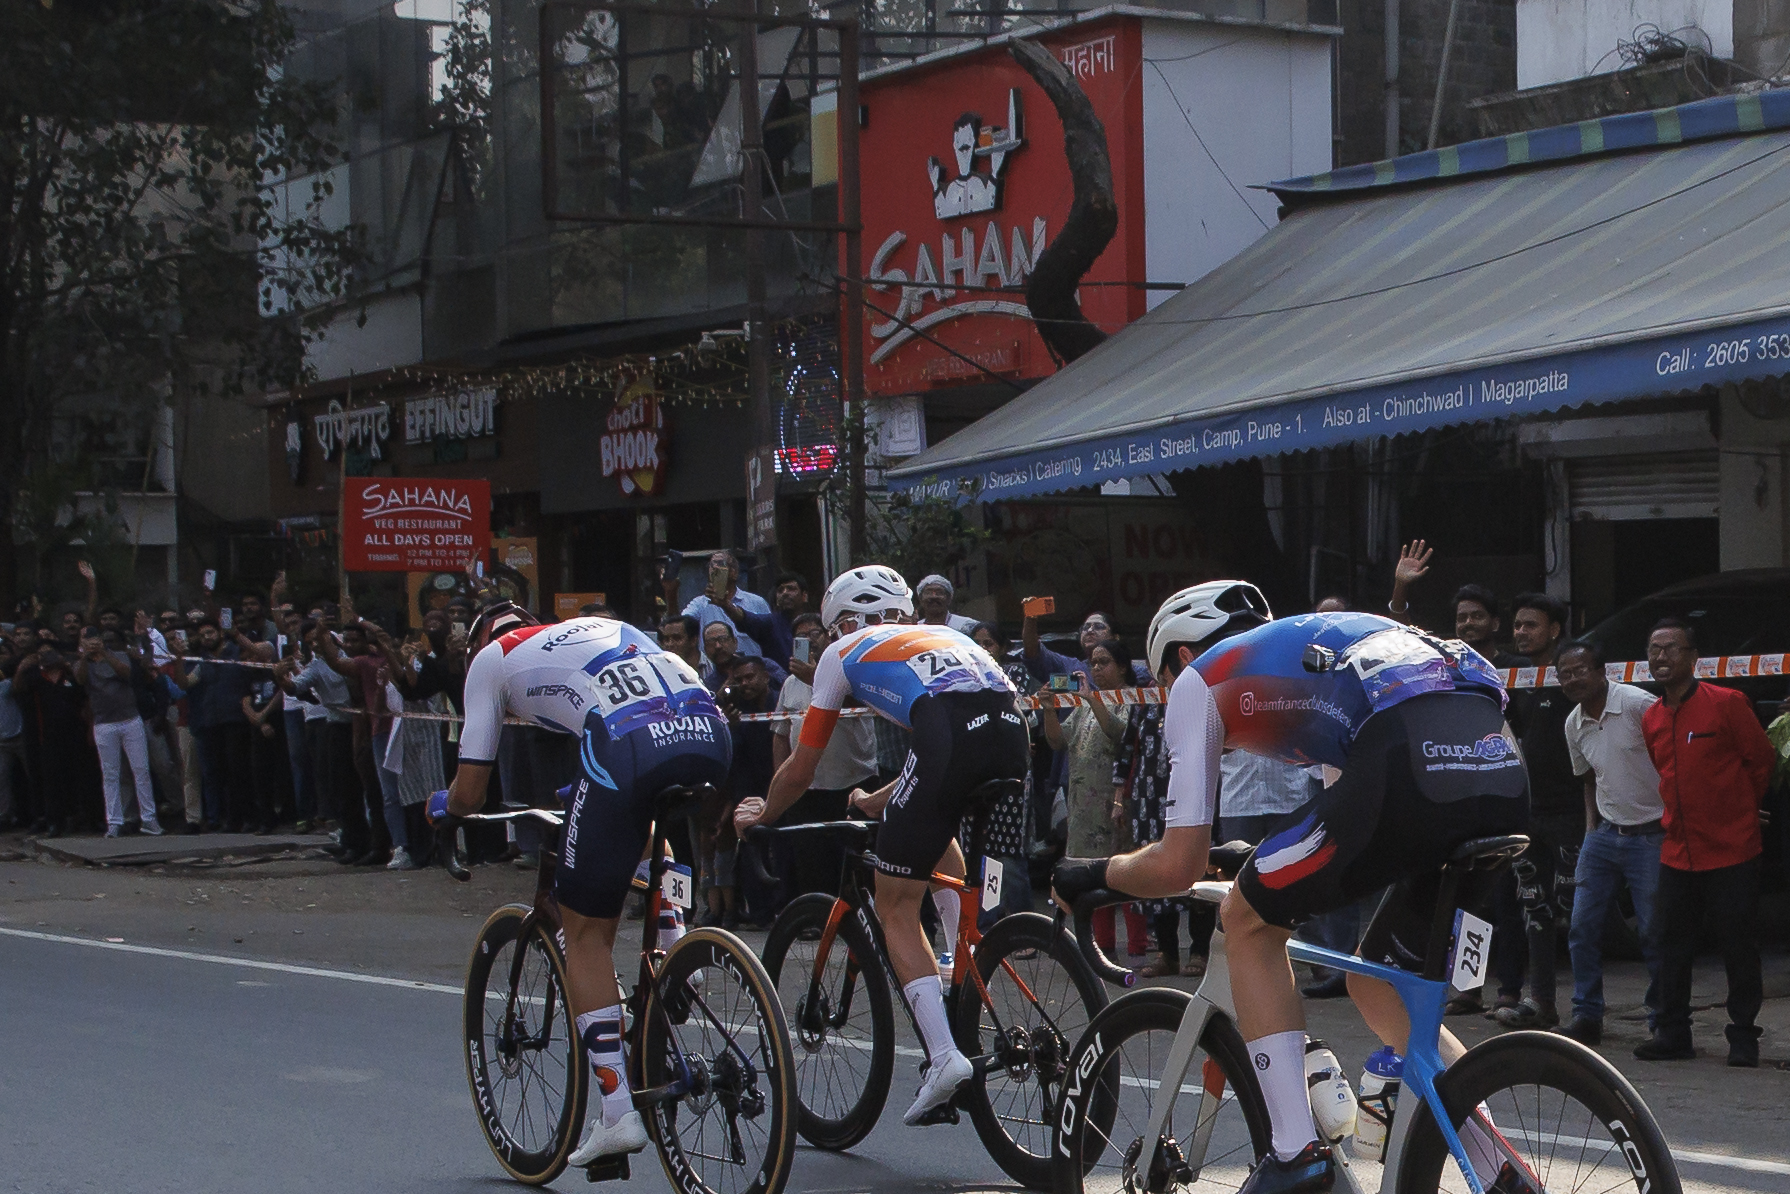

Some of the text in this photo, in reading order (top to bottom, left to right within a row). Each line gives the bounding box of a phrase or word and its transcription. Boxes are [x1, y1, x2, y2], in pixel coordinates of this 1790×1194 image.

[868, 216, 1082, 338] SAHAN
[1655, 349, 1698, 376] Call:
[1704, 338, 1750, 369] 2605
[1323, 369, 1568, 428] Also at Chinchwad Magarpatta
[405, 388, 498, 445] EFFINGUT
[600, 430, 659, 478] BHOOK
[1093, 448, 1125, 471] 2434,
[1128, 441, 1154, 464] East
[1160, 435, 1199, 459] Street,
[1202, 428, 1244, 450] Camp,
[1247, 420, 1282, 442] Pune
[1035, 455, 1082, 481] Catering
[362, 483, 472, 513] SAHANA
[374, 519, 462, 530] VEG RESTAURANT
[364, 533, 473, 546] ALL DAYS OPEN
[526, 684, 585, 711] WINSPACE
[599, 663, 651, 705] 36
[648, 716, 712, 739] ROOJAI
[967, 713, 990, 731] LAZER
[1000, 711, 1021, 725] LAZER
[653, 732, 716, 748] INSURANCE
[1422, 741, 1475, 761] Groupe
[564, 778, 590, 869] WINSPACE
[671, 878, 684, 899] 36
[986, 875, 999, 895] 25
[1460, 930, 1485, 978] 234
[1059, 1032, 1104, 1158] roval
